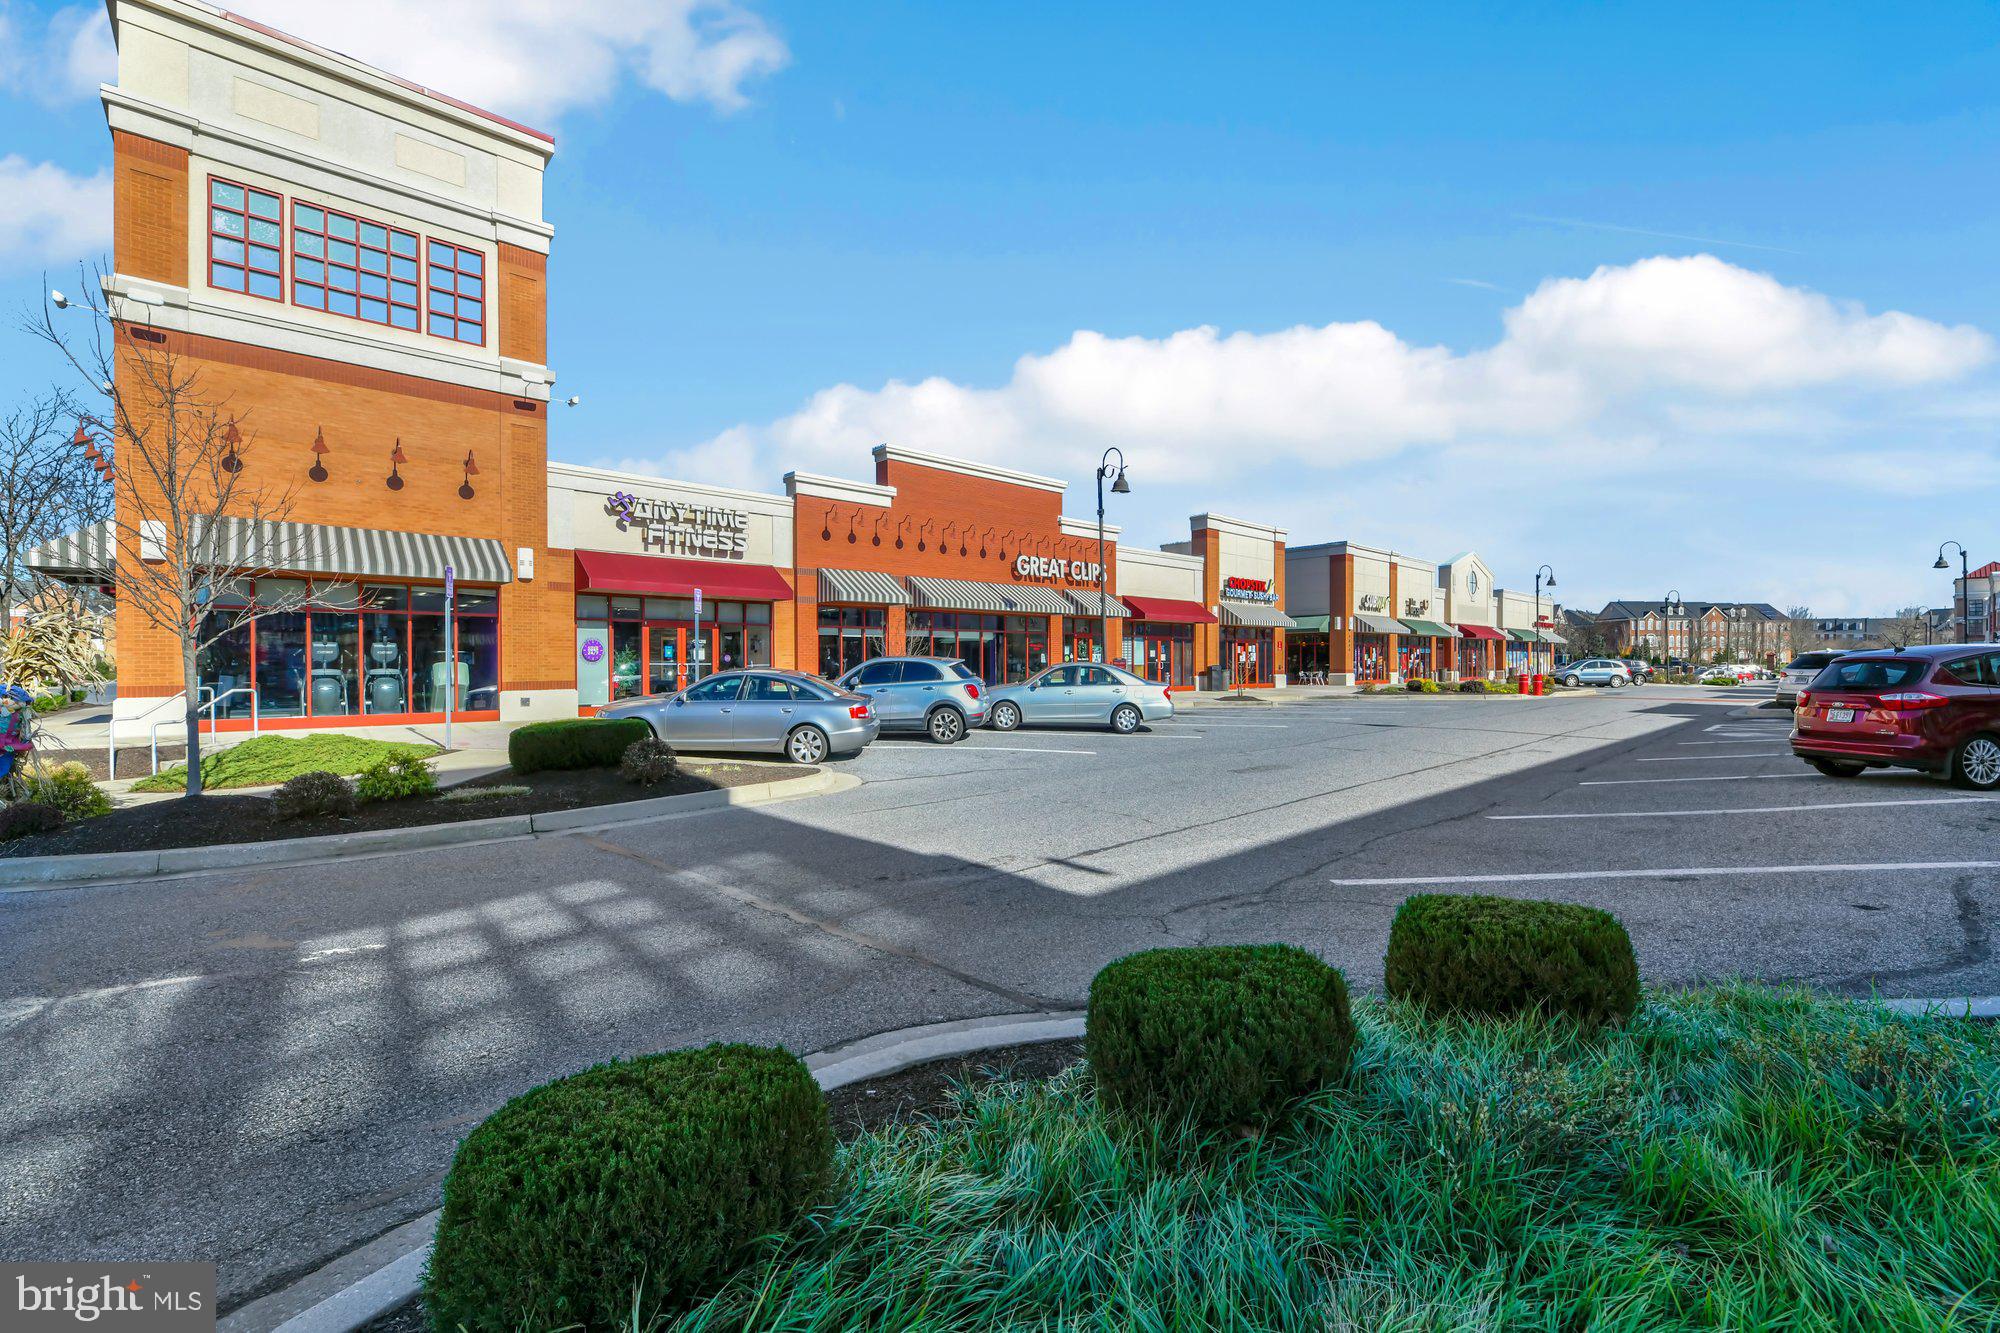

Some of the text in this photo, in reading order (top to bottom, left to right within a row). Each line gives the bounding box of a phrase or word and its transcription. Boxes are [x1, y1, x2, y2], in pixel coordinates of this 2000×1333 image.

[633, 497, 750, 529] ANYTIME
[648, 523, 750, 552] FITNESS
[1016, 555, 1067, 578] GREAT
